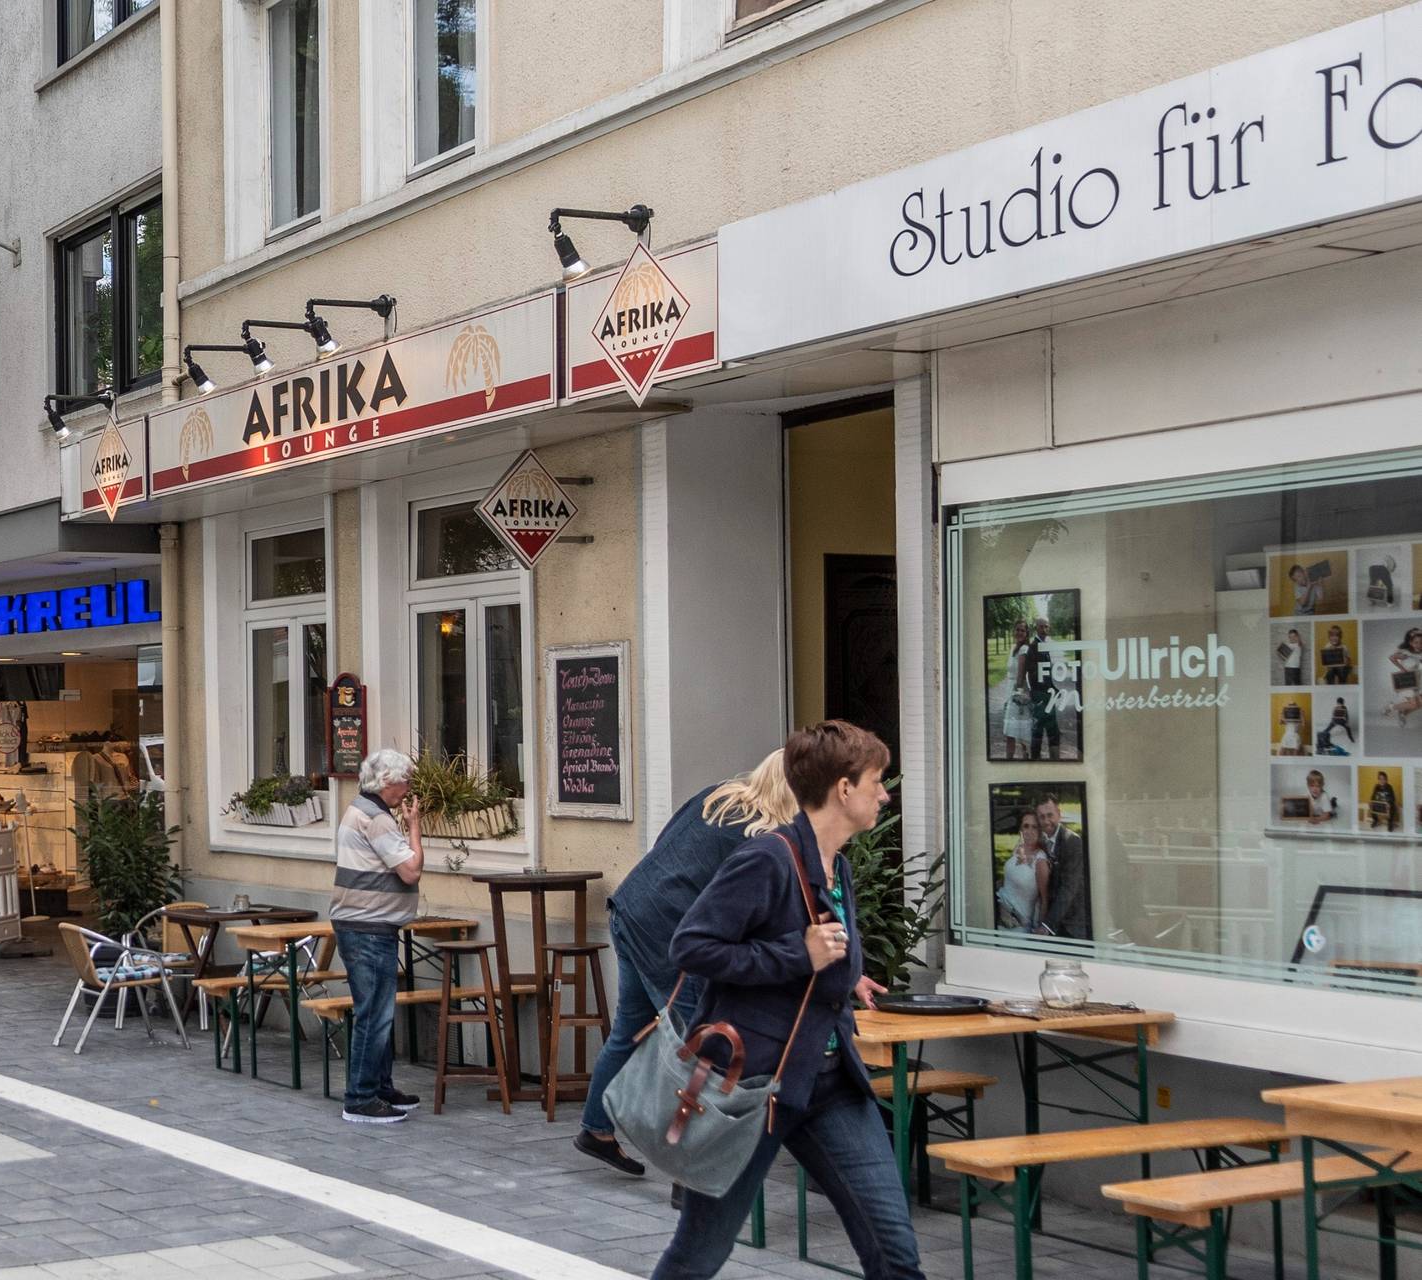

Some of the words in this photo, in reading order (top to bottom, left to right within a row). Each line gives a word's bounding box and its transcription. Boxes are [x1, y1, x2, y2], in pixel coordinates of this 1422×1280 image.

[889, 146, 1120, 277] Studio
[1152, 101, 1265, 211] für
[600, 296, 681, 340] AFRIKA
[612, 329, 668, 350] LOUNGE
[242, 349, 407, 445] AFRIKA
[263, 420, 380, 463] LOUNGE
[94, 452, 129, 476] AFRIKA
[492, 498, 570, 518] AFRIKA
[504, 519, 559, 527] LOUNGE
[1037, 660, 1098, 683] FOTO
[1099, 633, 1235, 681] Ullrich
[1044, 682, 1232, 714] Msterbetrieb
[562, 715, 595, 731] Orange
[562, 742, 612, 759] Grenadine
[590, 759, 619, 776] Brandy
[562, 777, 595, 793] Wodka
